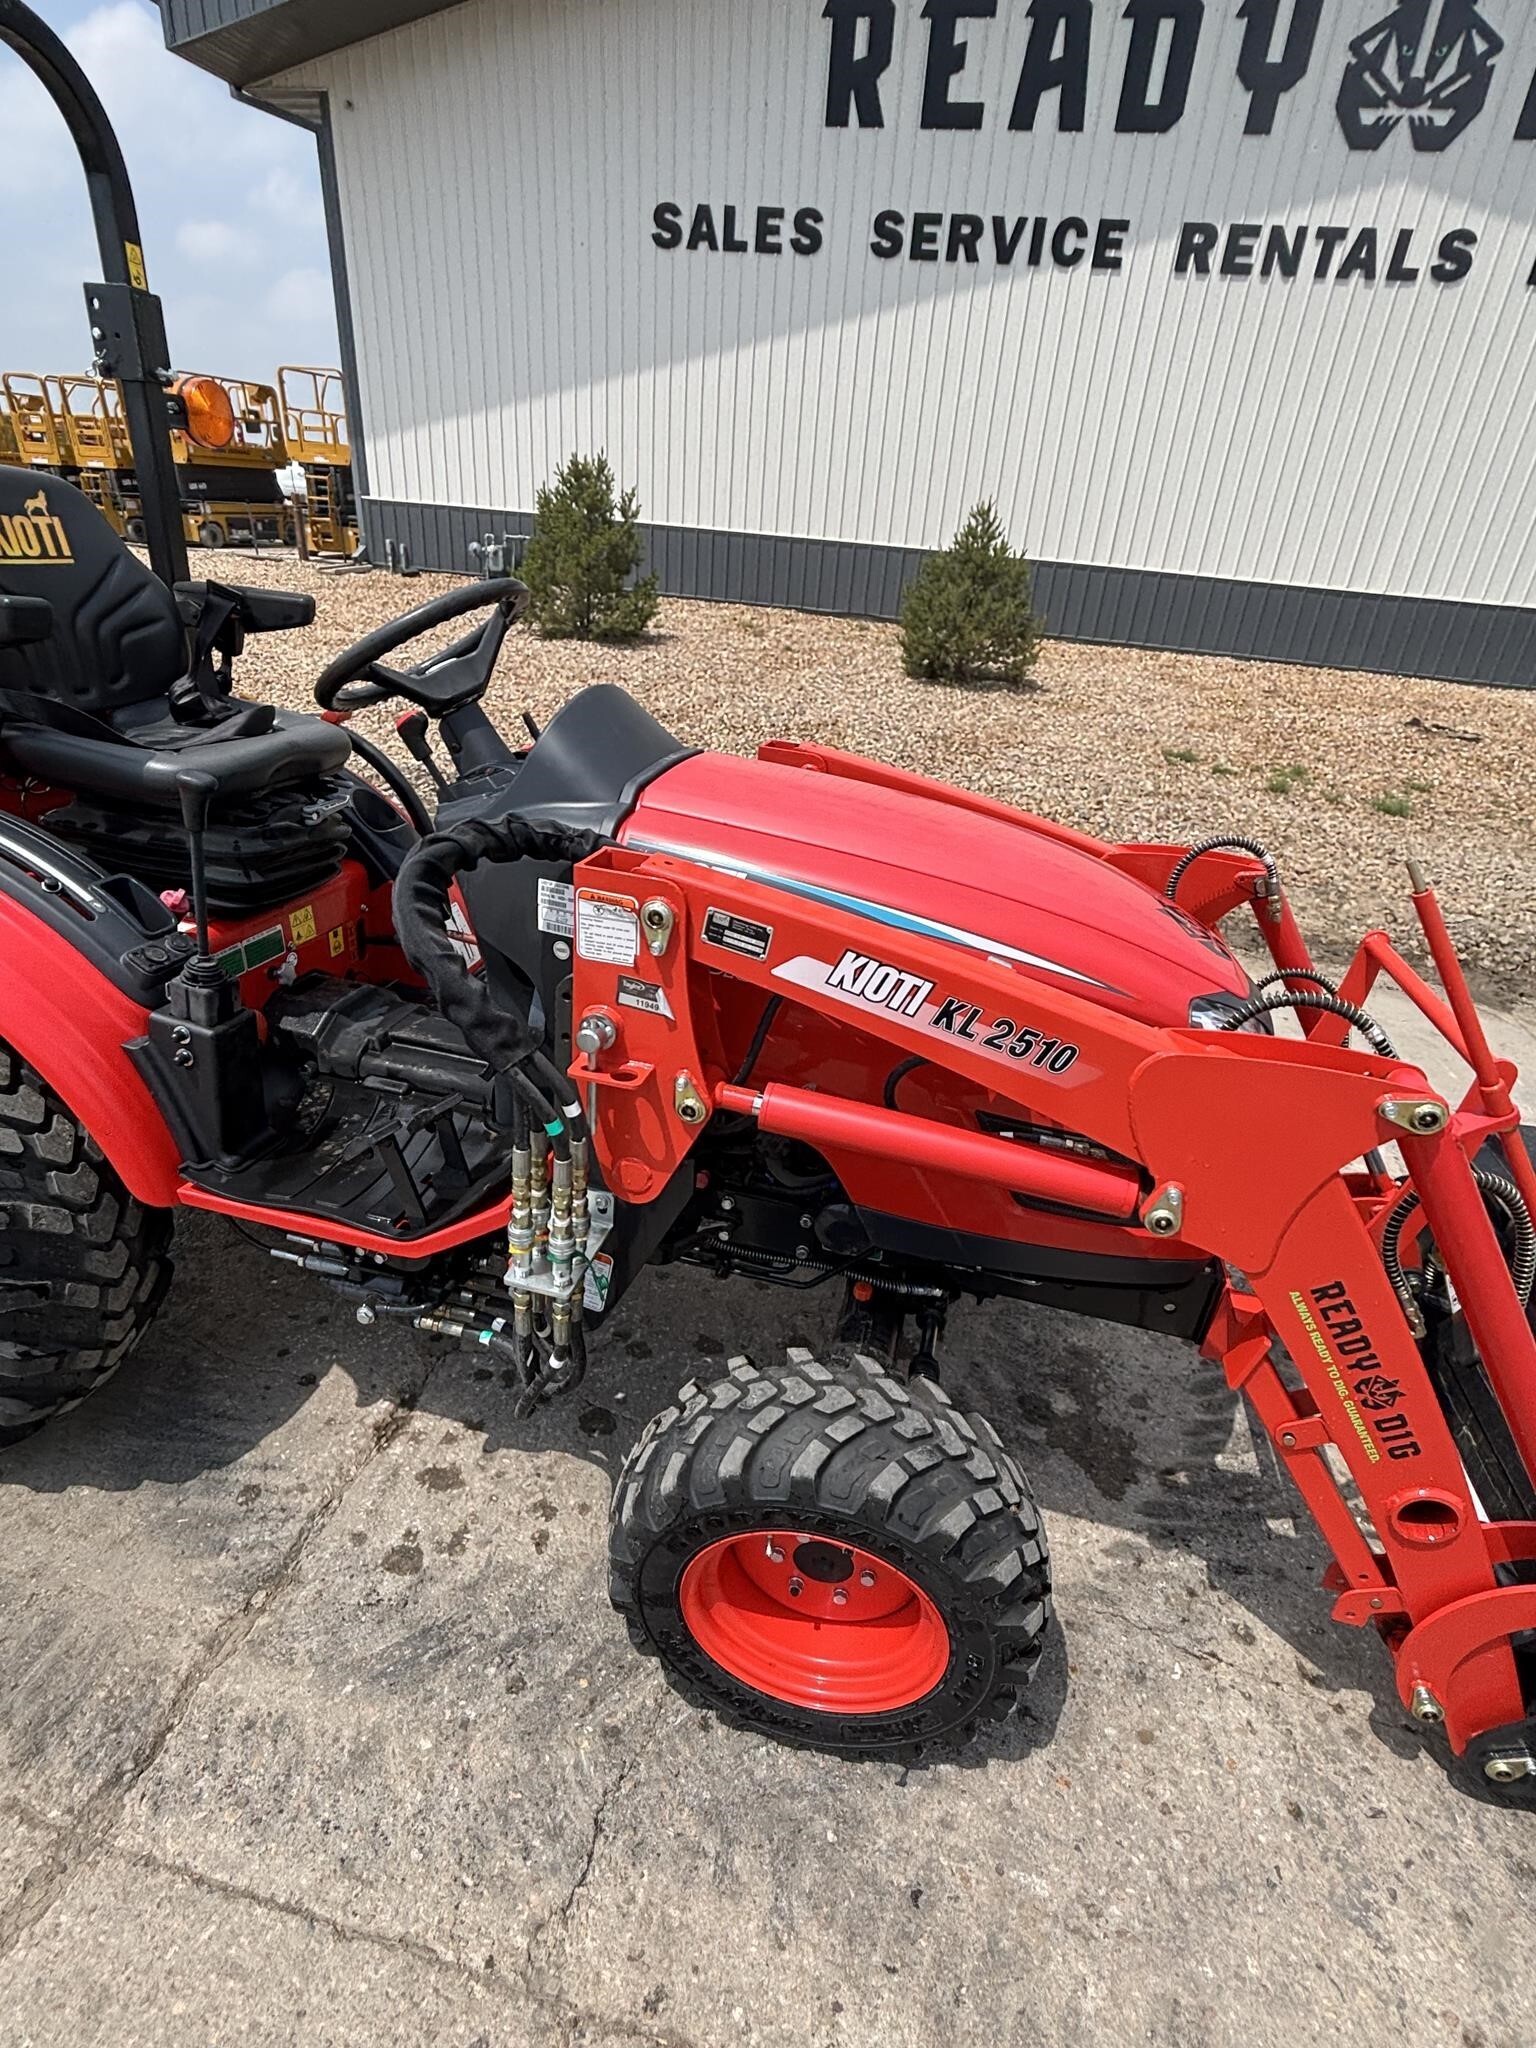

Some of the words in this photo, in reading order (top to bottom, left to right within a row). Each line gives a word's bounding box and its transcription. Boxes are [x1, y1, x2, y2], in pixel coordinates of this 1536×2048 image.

[822, 0, 1323, 136] READY
[651, 202, 825, 256] SALES
[869, 209, 1130, 270] SERVICE
[1173, 221, 1478, 285] RENTALS
[635, 999, 660, 1011] 11949
[825, 949, 937, 1017] KIOTI
[930, 996, 984, 1041] KL
[979, 1017, 1080, 1075] 2510
[1289, 1291, 1317, 1332] ALWAYS
[1309, 1331, 1334, 1364] READY
[1326, 1364, 1340, 1379] TO
[1343, 1400, 1381, 1465] GUARANTEED.
[1310, 1280, 1382, 1371] READY
[1372, 1413, 1422, 1461] DIG
